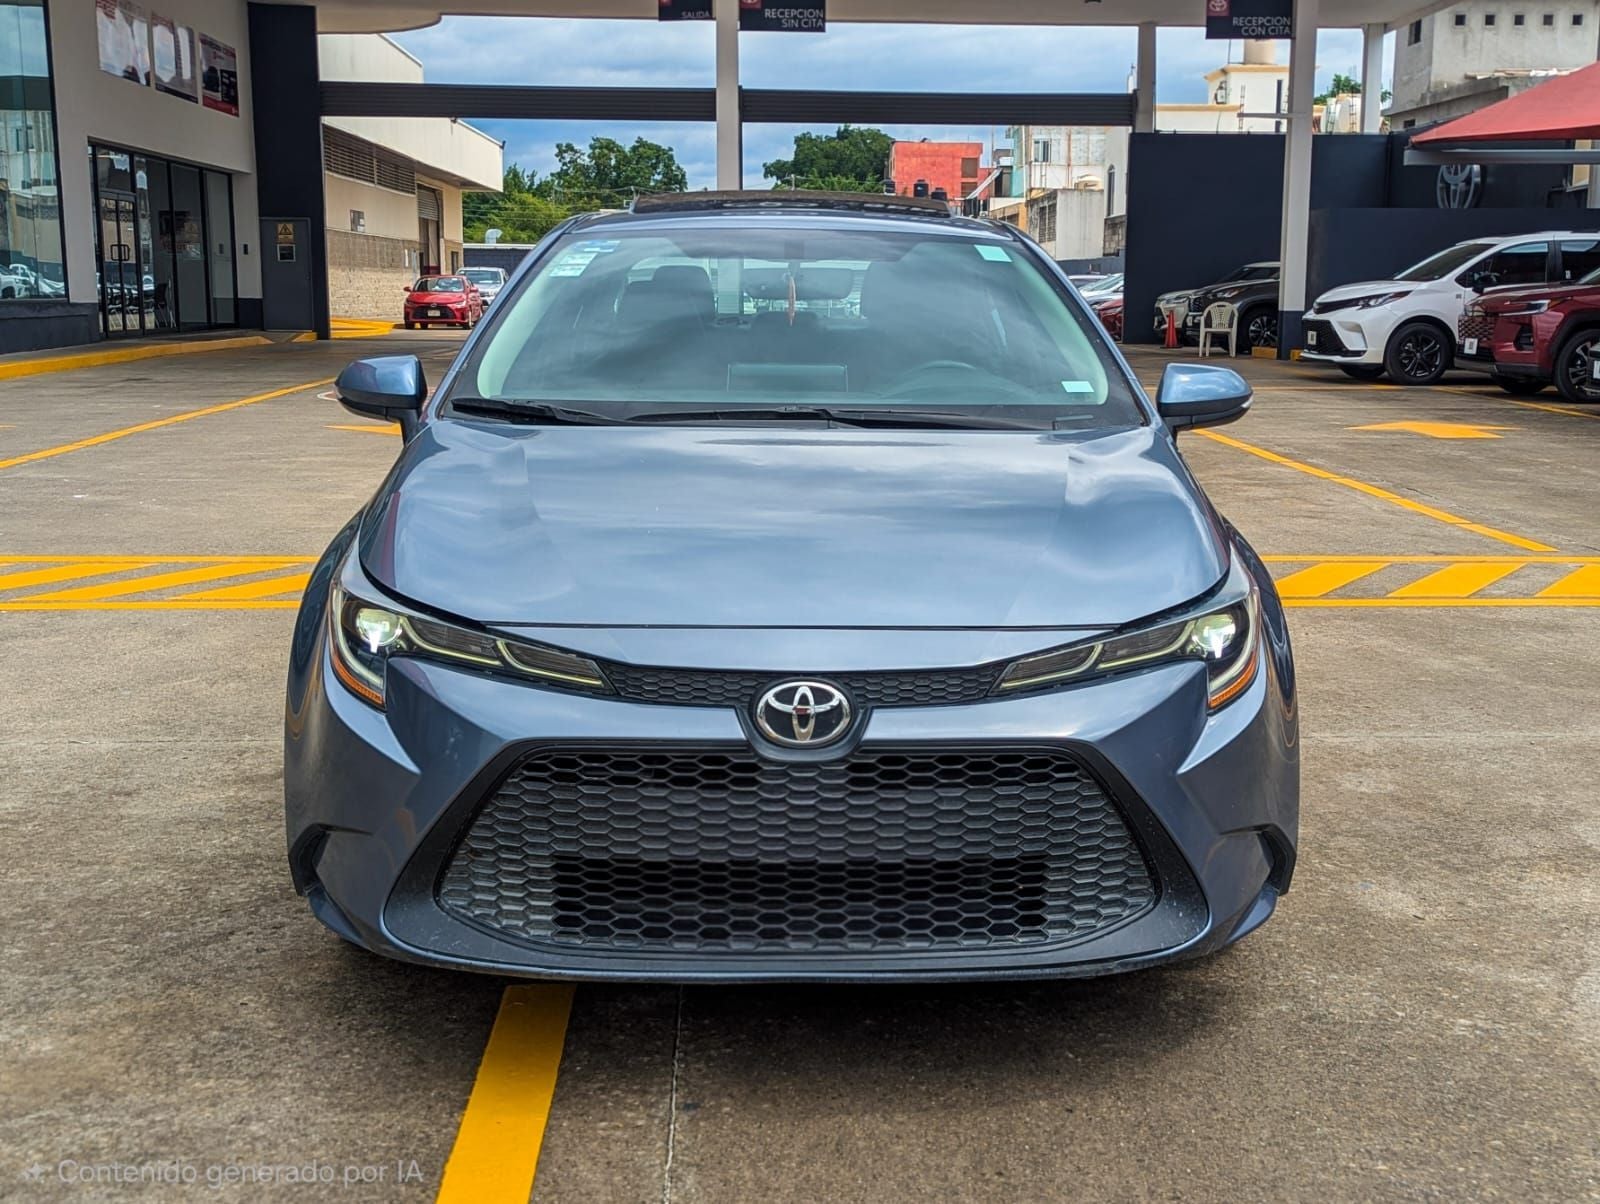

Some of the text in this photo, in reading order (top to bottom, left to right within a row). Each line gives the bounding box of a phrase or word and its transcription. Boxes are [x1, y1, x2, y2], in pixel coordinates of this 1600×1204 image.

[681, 11, 710, 19] SALIDA
[764, 8, 824, 19] RECEPCION
[782, 19, 824, 28] SIN CITA
[1232, 16, 1290, 26] RECEPCION
[1241, 26, 1291, 36] CON CITA
